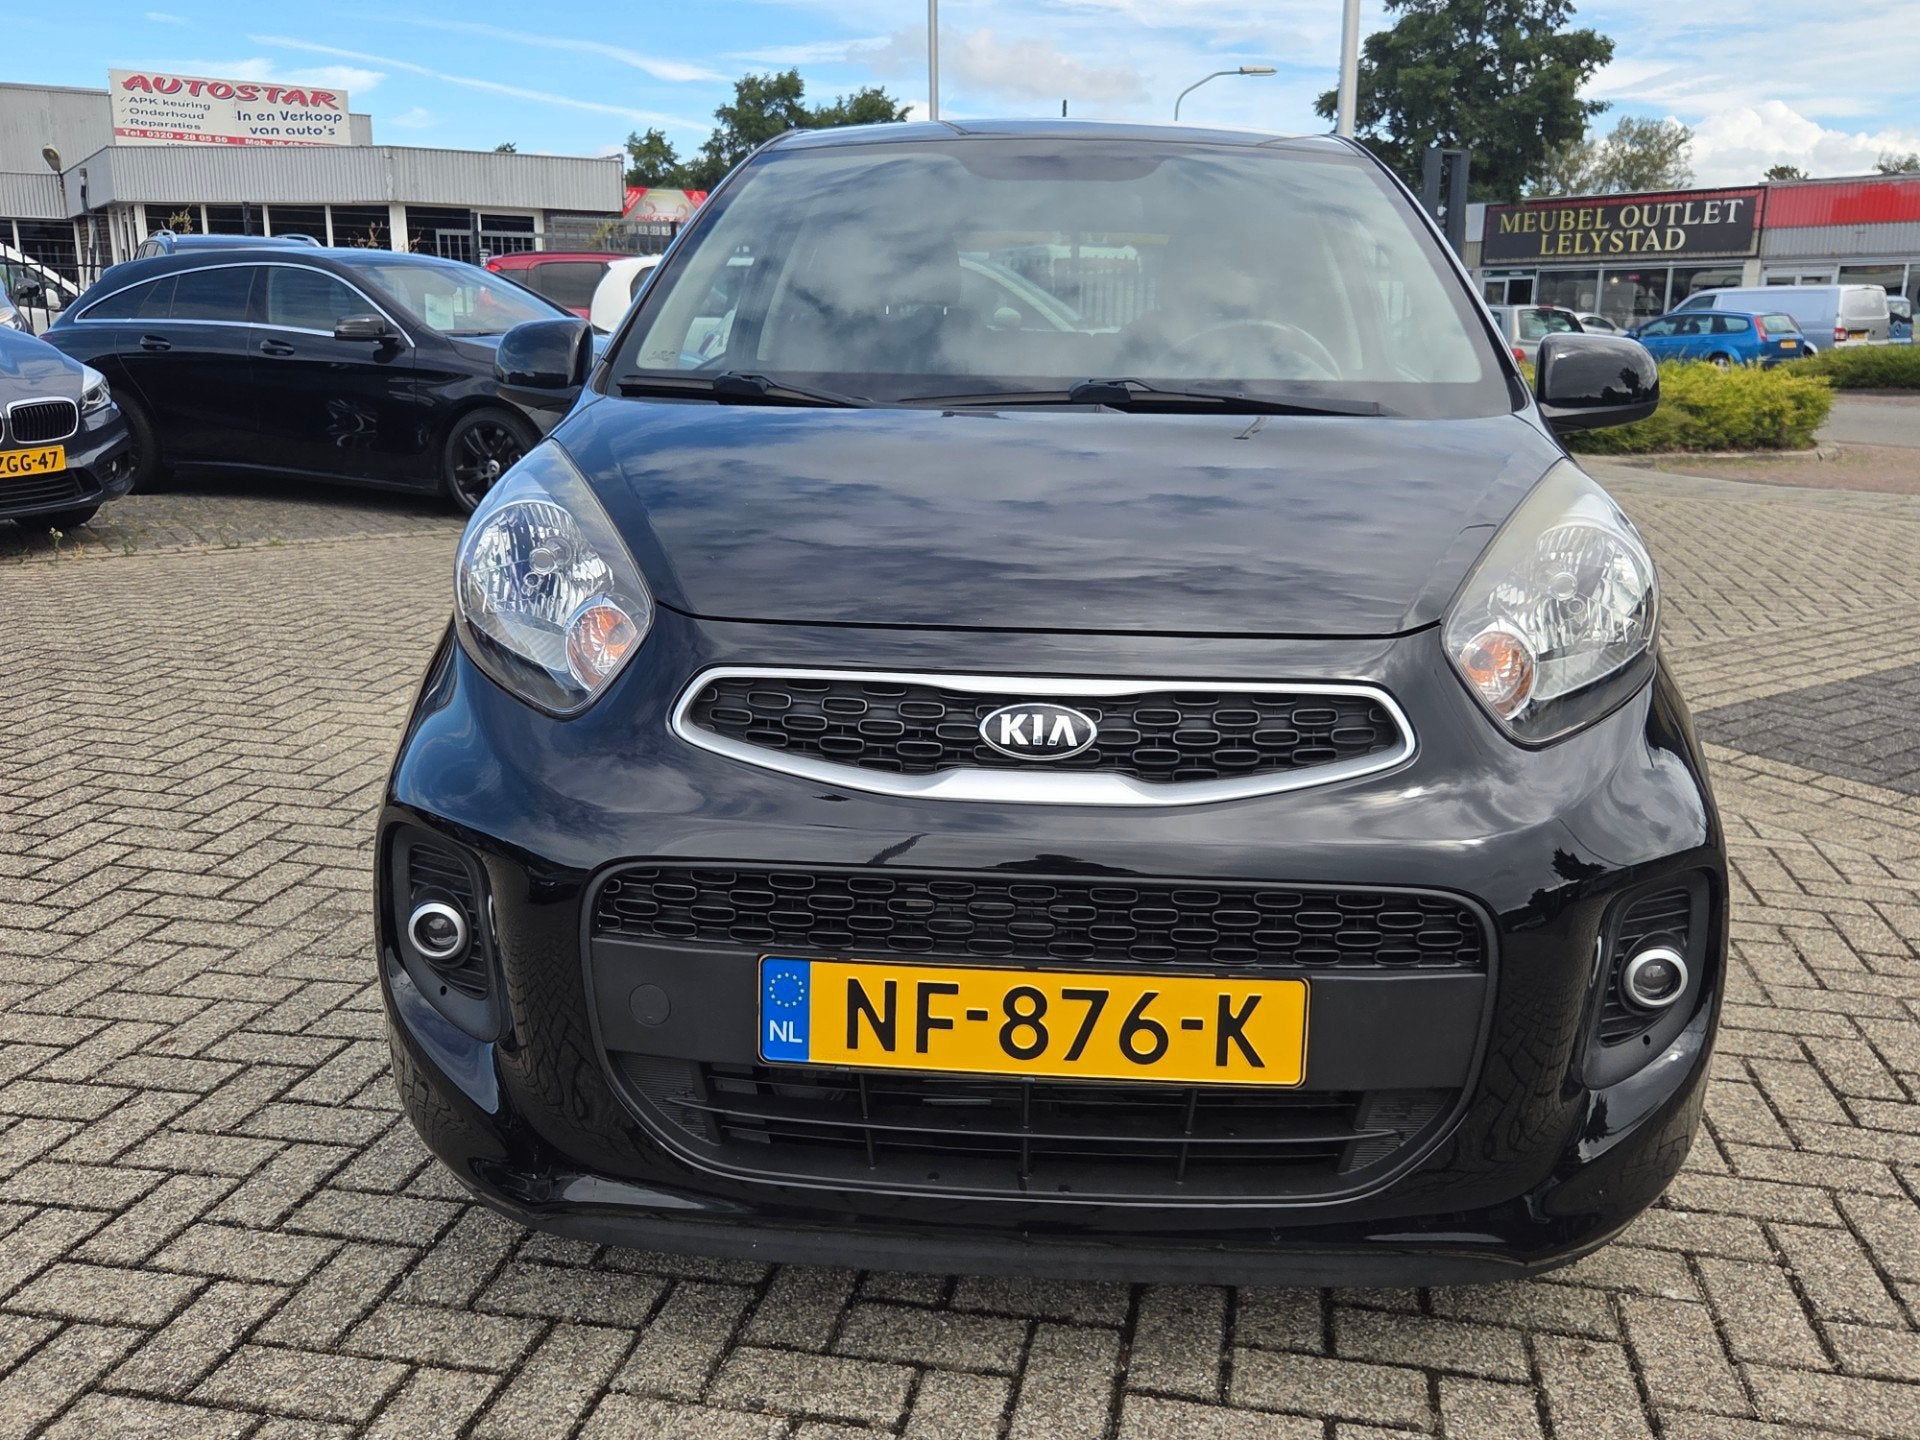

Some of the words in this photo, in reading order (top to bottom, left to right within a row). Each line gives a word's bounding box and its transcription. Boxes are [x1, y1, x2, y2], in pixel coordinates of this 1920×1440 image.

[121, 75, 340, 110] AUTOSTAR
[128, 96, 159, 106] APK
[162, 99, 211, 111] keuring
[129, 107, 205, 120] Onderhoud
[237, 110, 252, 121] In
[256, 112, 276, 122] en
[279, 110, 343, 125] Verkoop
[123, 129, 144, 138] Tel.
[146, 130, 174, 139] 0320
[130, 118, 202, 131] Reparaties
[249, 126, 280, 136] van
[285, 124, 336, 136] auto's
[1499, 208, 1612, 235] MEUBEL
[1619, 199, 1744, 229] OUTLET
[1539, 227, 1687, 256] LELYSTAD
[999, 713, 1078, 747] KIA
[769, 1019, 803, 1043] NL
[845, 977, 1266, 1069] NF-876-K
